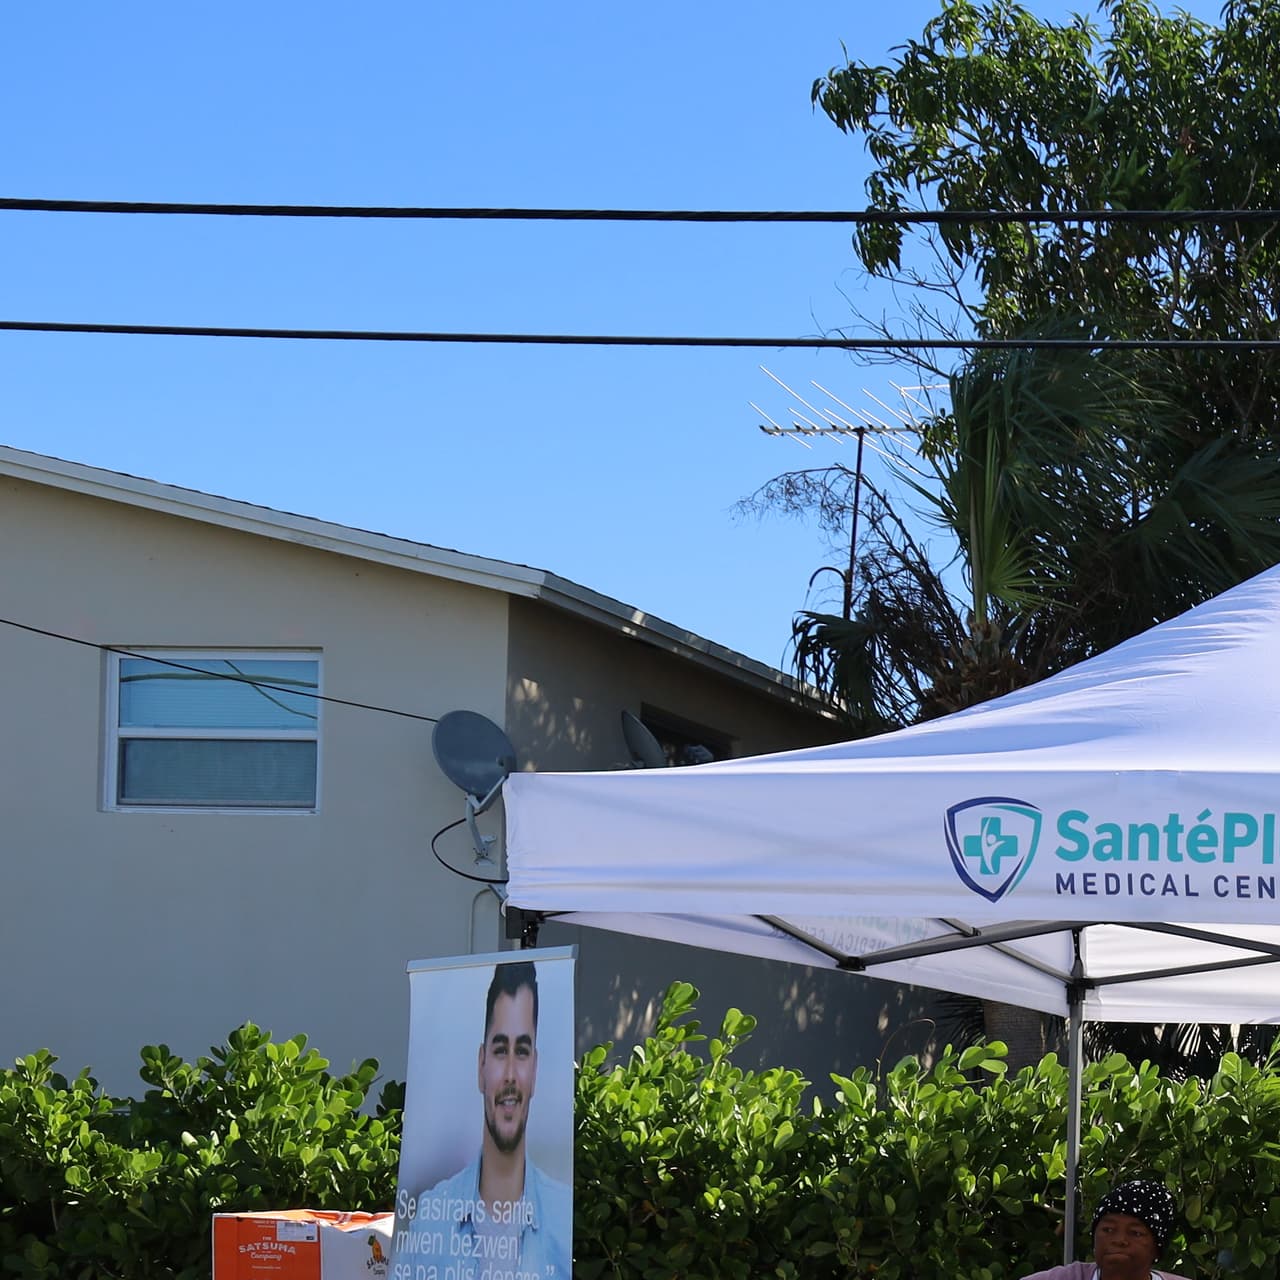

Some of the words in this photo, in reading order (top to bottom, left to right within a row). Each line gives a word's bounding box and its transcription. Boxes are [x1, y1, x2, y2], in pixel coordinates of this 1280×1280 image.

[1055, 871, 1200, 898] MEDICAL
[420, 1192, 486, 1224] asirans
[238, 1242, 297, 1255] SATSUMA
[250, 1251, 282, 1262] Company
[395, 1230, 443, 1255] mwen
[450, 1226, 522, 1266] bezwen,
